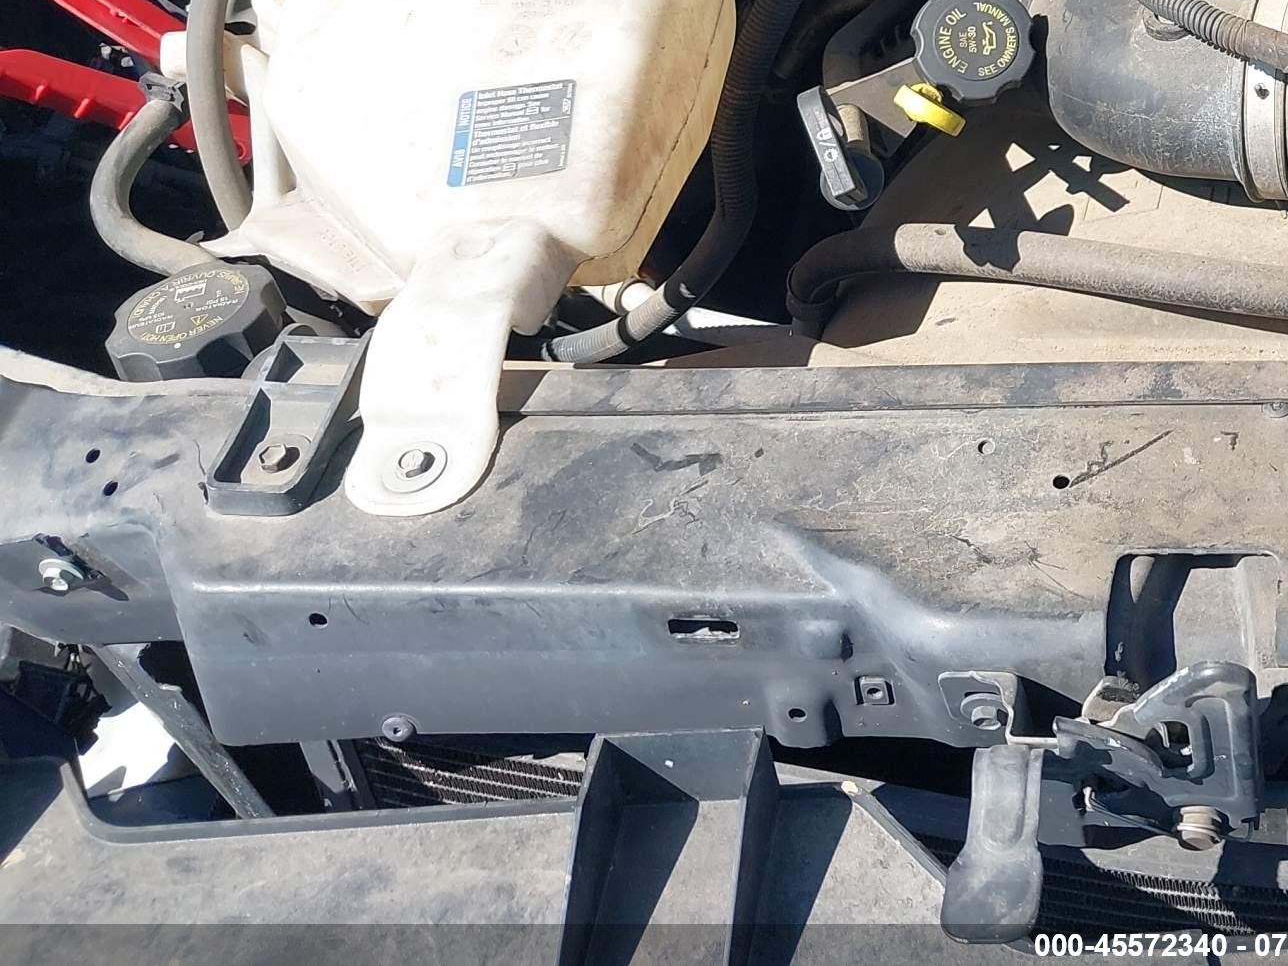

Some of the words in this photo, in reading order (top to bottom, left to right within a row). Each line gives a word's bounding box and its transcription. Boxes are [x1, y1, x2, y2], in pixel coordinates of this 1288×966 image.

[945, 8, 967, 25] OIL
[973, 2, 1011, 27] MANUAL
[959, 31, 967, 48] SAE
[967, 26, 977, 53] 5W-30
[997, 27, 1017, 67] OWNER'S
[938, 26, 968, 74] ENGINE
[978, 64, 998, 77] SEE
[518, 83, 563, 96] Thermostat
[459, 98, 472, 126] NOTICE
[452, 149, 465, 167] AVIS
[171, 270, 216, 285] OUVRIR
[195, 299, 238, 312] RADIATOR
[128, 314, 174, 329] RADIATEUR
[188, 315, 224, 336] NEVER
[161, 331, 187, 342] OPEN
